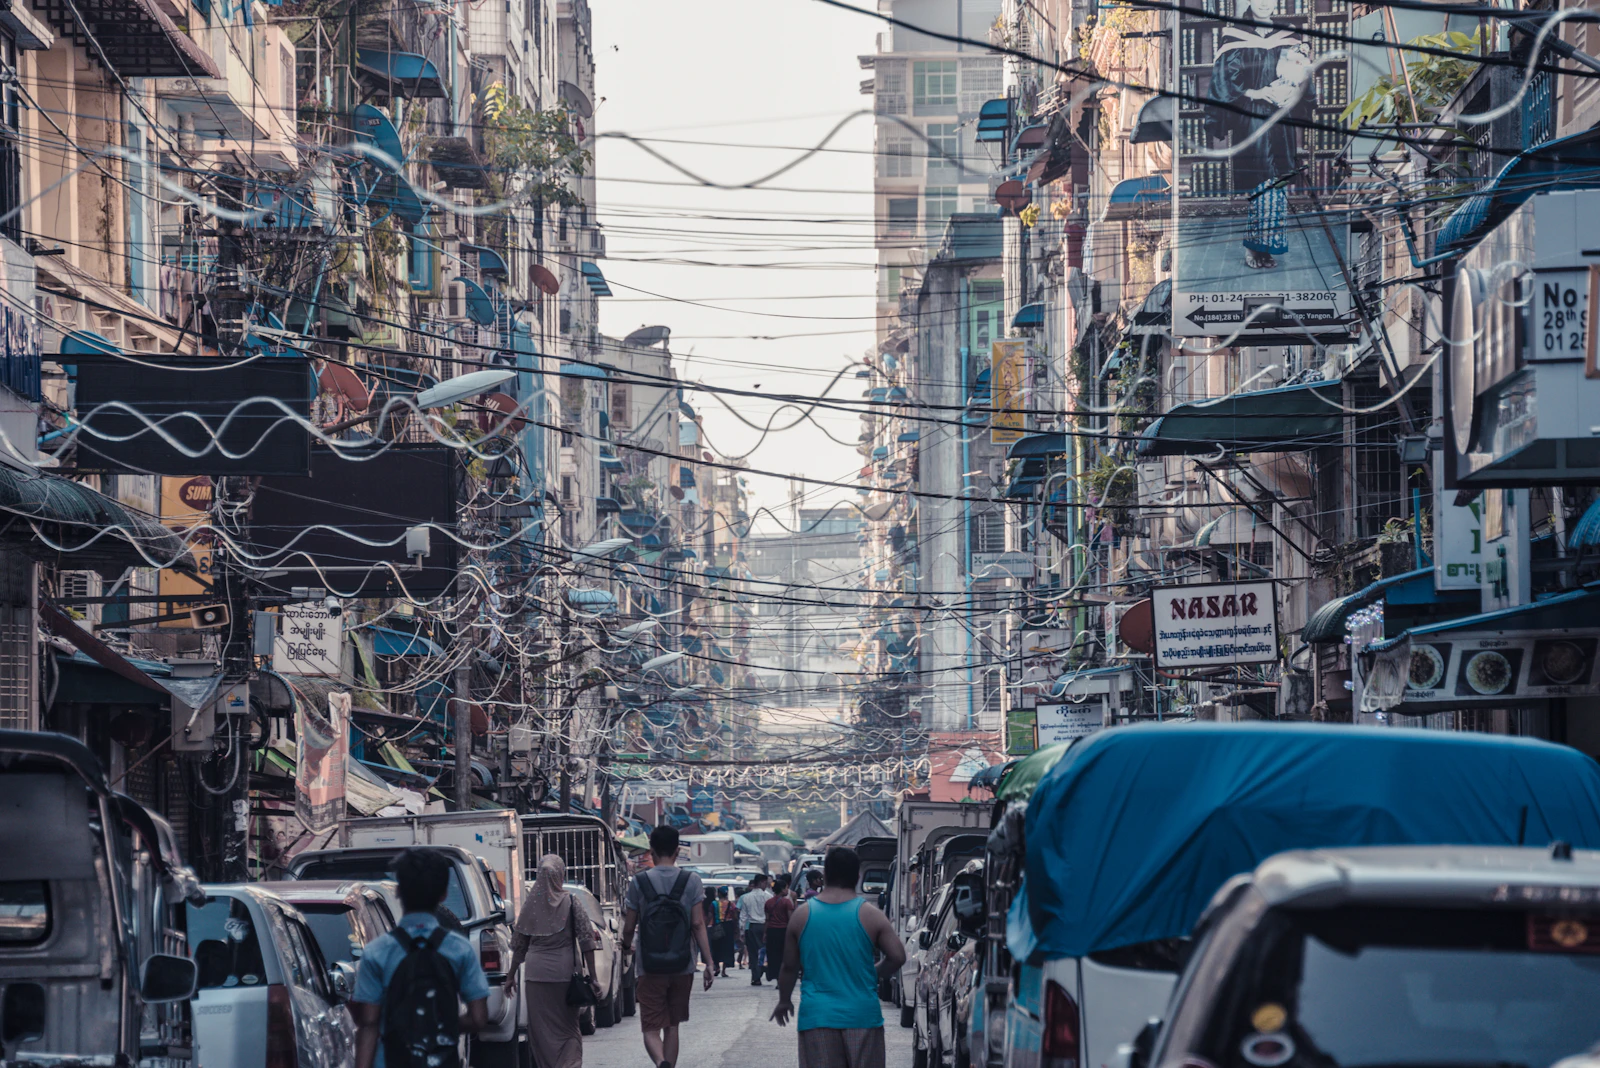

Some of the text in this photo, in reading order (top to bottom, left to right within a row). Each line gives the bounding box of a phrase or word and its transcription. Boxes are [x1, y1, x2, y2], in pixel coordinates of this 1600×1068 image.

[1189, 294, 1208, 303] PH:
[1544, 282, 1577, 308] No
[1306, 312, 1333, 321] Yangon.
[1544, 332, 1562, 350] 01
[1170, 592, 1259, 620] NASAR
